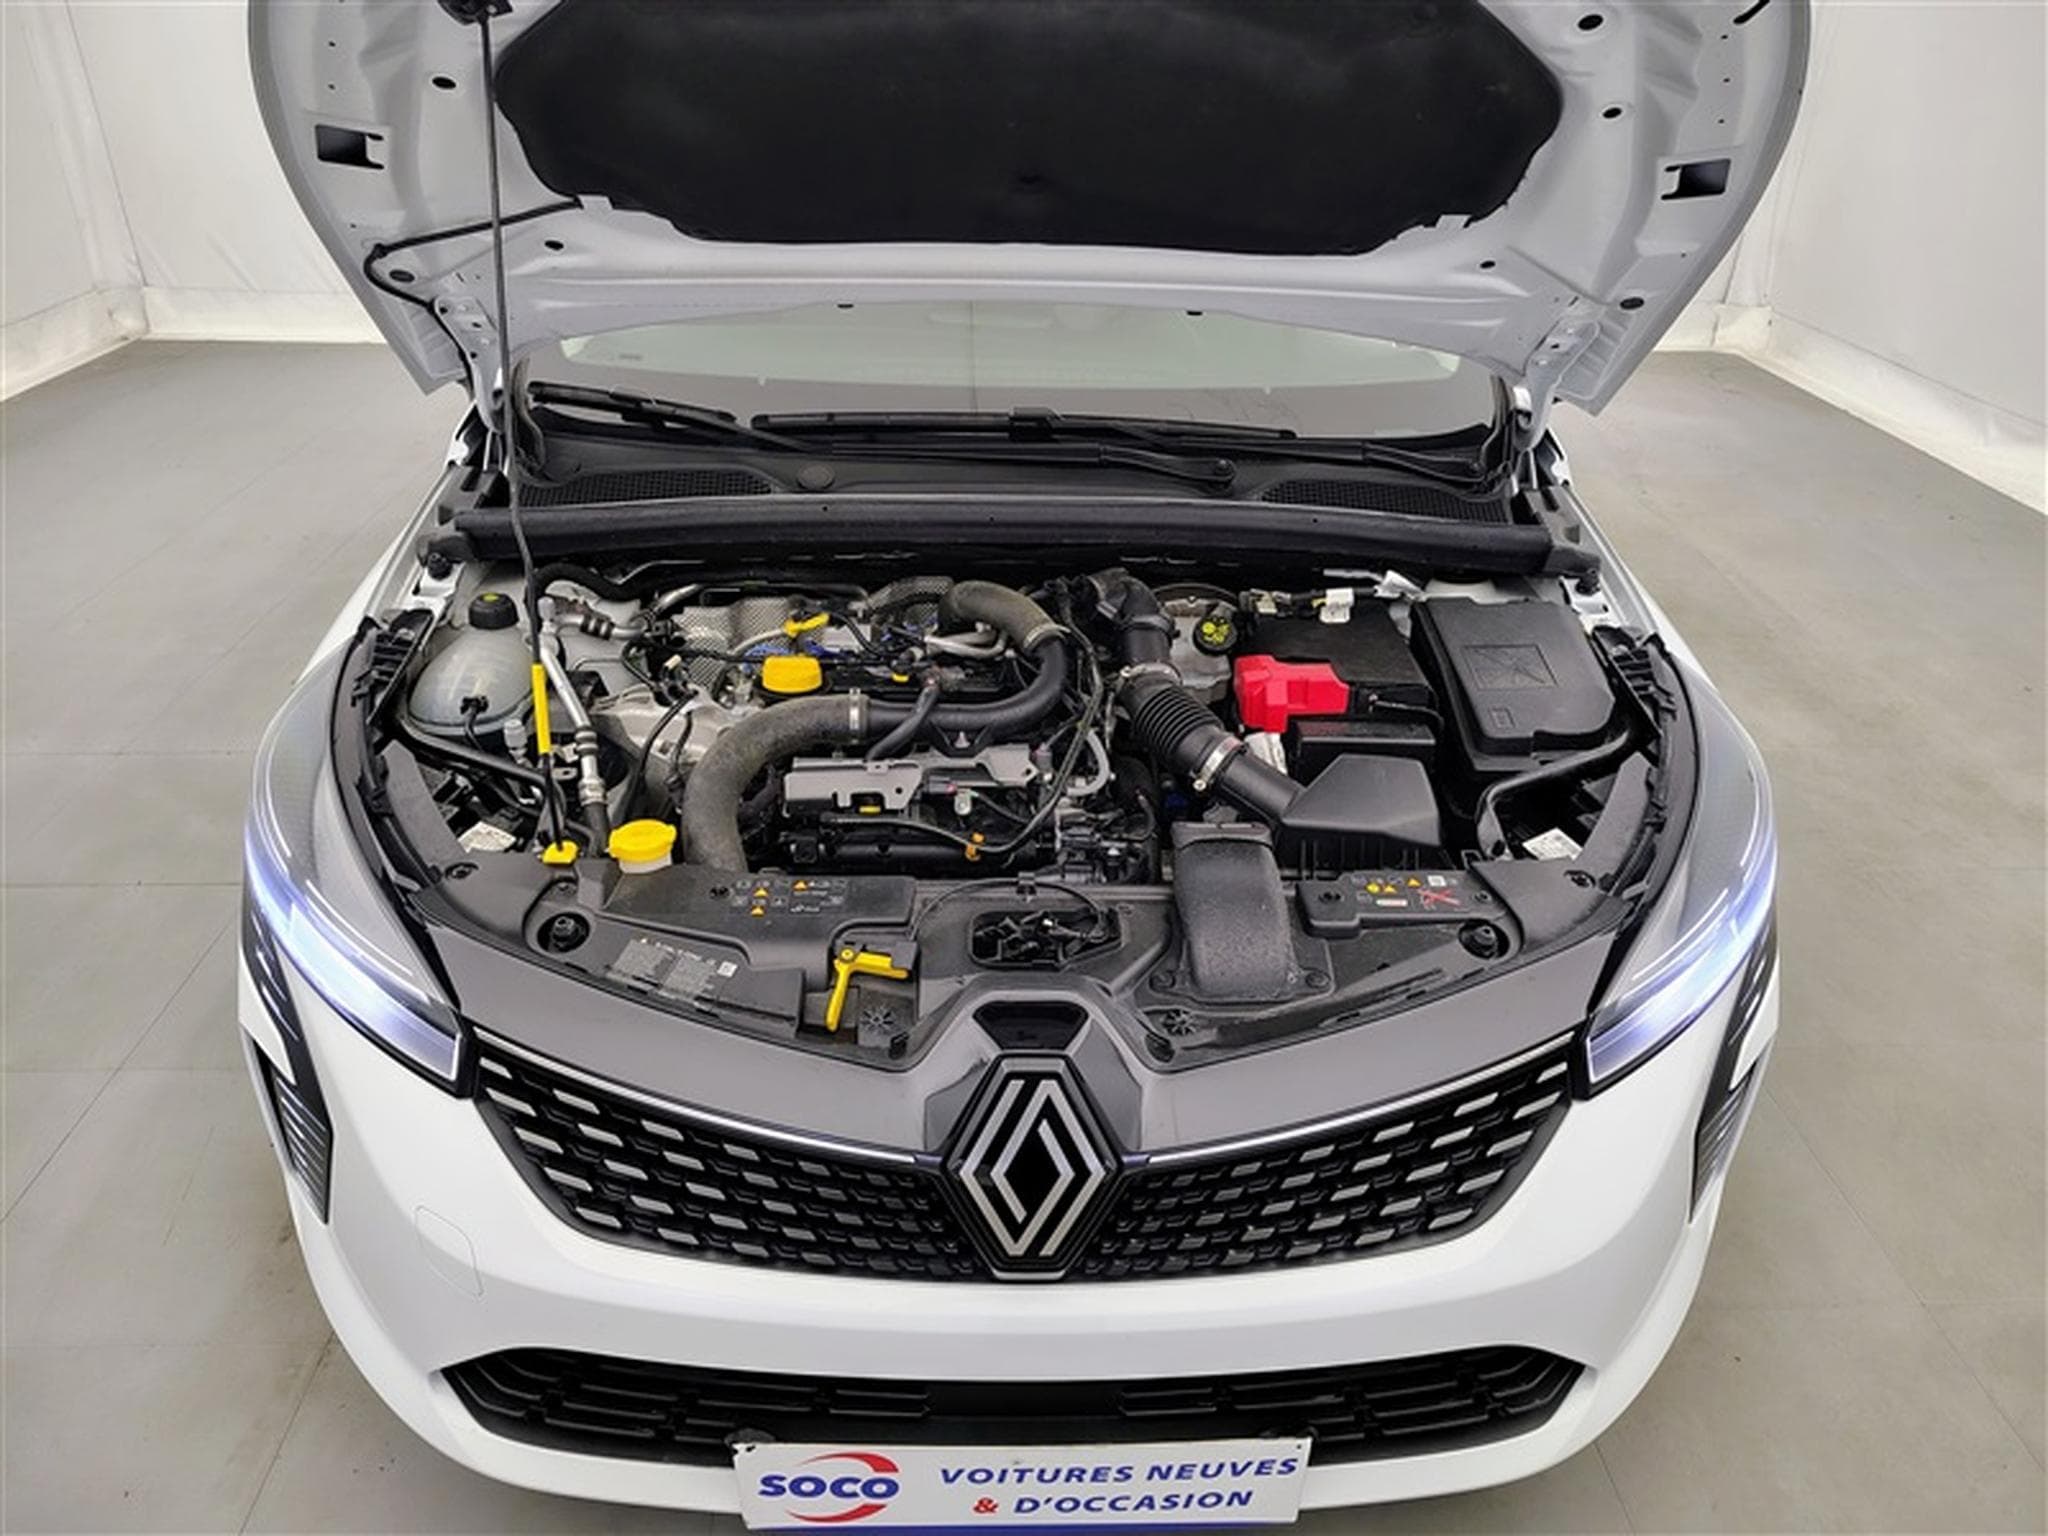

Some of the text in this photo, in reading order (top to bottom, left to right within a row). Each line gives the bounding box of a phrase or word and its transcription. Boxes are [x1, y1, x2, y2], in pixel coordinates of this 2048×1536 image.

[940, 1457, 1299, 1485] VOITURES NEUVES
[758, 1474, 899, 1499] SOCO
[973, 1490, 1253, 1514] & D'OCCASION
